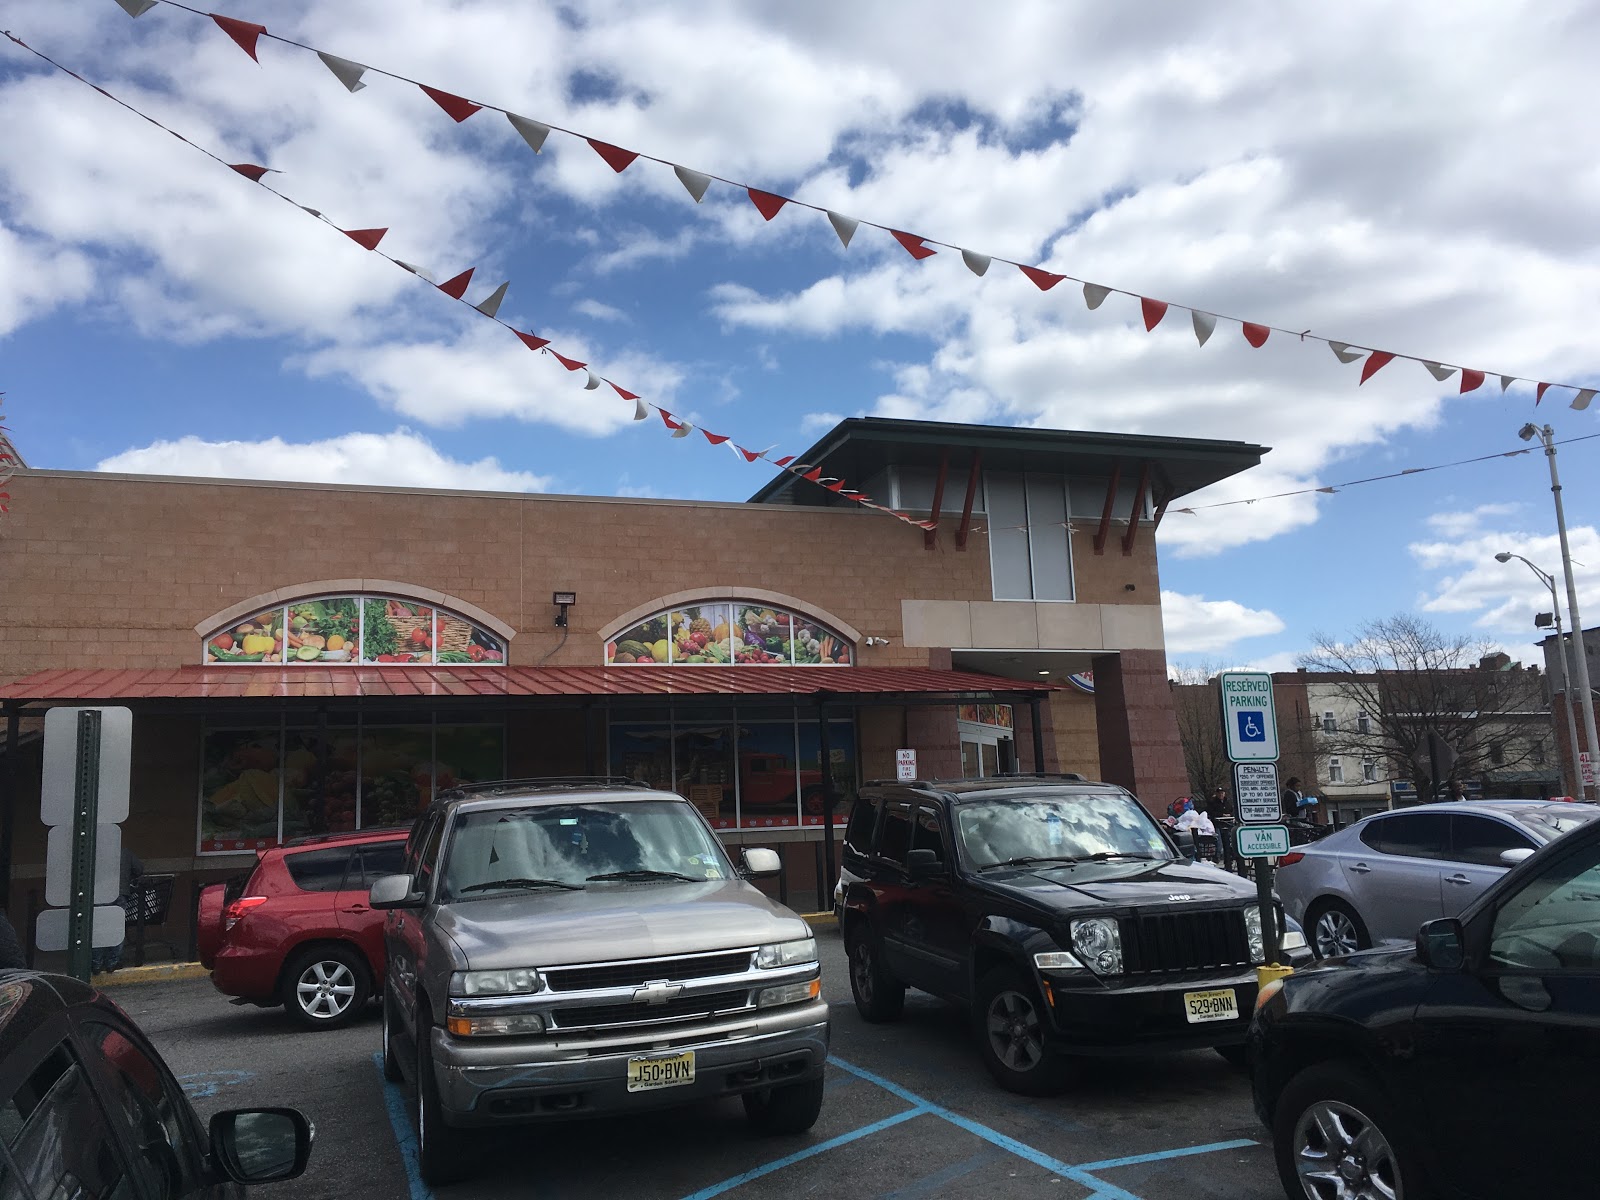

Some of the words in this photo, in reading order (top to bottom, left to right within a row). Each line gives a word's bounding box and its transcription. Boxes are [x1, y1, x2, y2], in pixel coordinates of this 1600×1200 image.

[1226, 681, 1268, 691] RESERVED
[1230, 696, 1267, 706] PARKING
[1254, 832, 1273, 841] VAN
